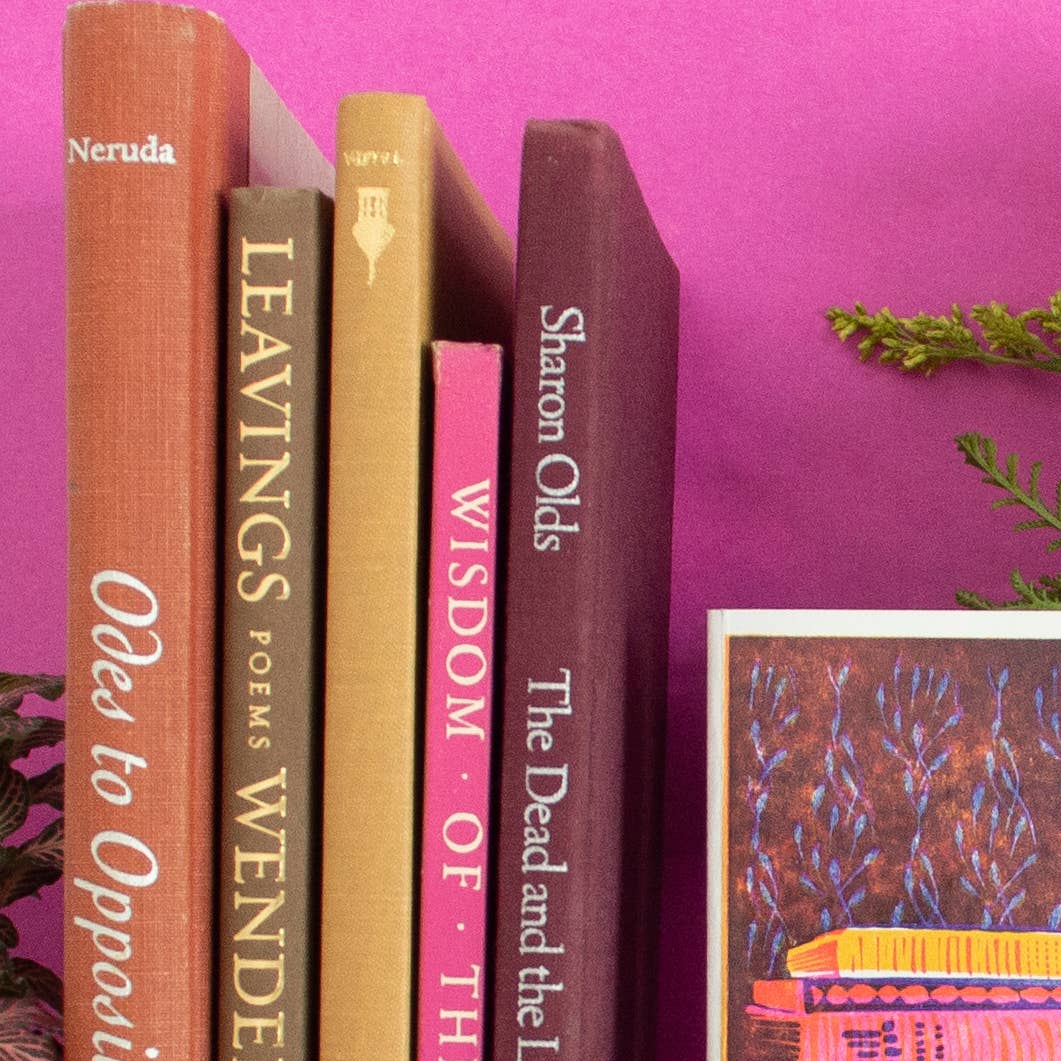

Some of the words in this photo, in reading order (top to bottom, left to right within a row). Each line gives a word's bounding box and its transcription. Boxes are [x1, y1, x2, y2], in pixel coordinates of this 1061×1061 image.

[67, 134, 177, 165] Neruda
[237, 236, 295, 604] LEAVINGS
[538, 305, 587, 444] Sharon
[533, 453, 580, 552] Olds
[90, 569, 163, 723] Odes
[445, 478, 492, 741] WISDOM
[248, 629, 272, 750] POEMS
[526, 667, 573, 753] The
[91, 743, 148, 807] to
[521, 764, 570, 874] Dead
[442, 811, 484, 891] OF
[517, 882, 565, 956] and
[516, 964, 565, 1026] the
